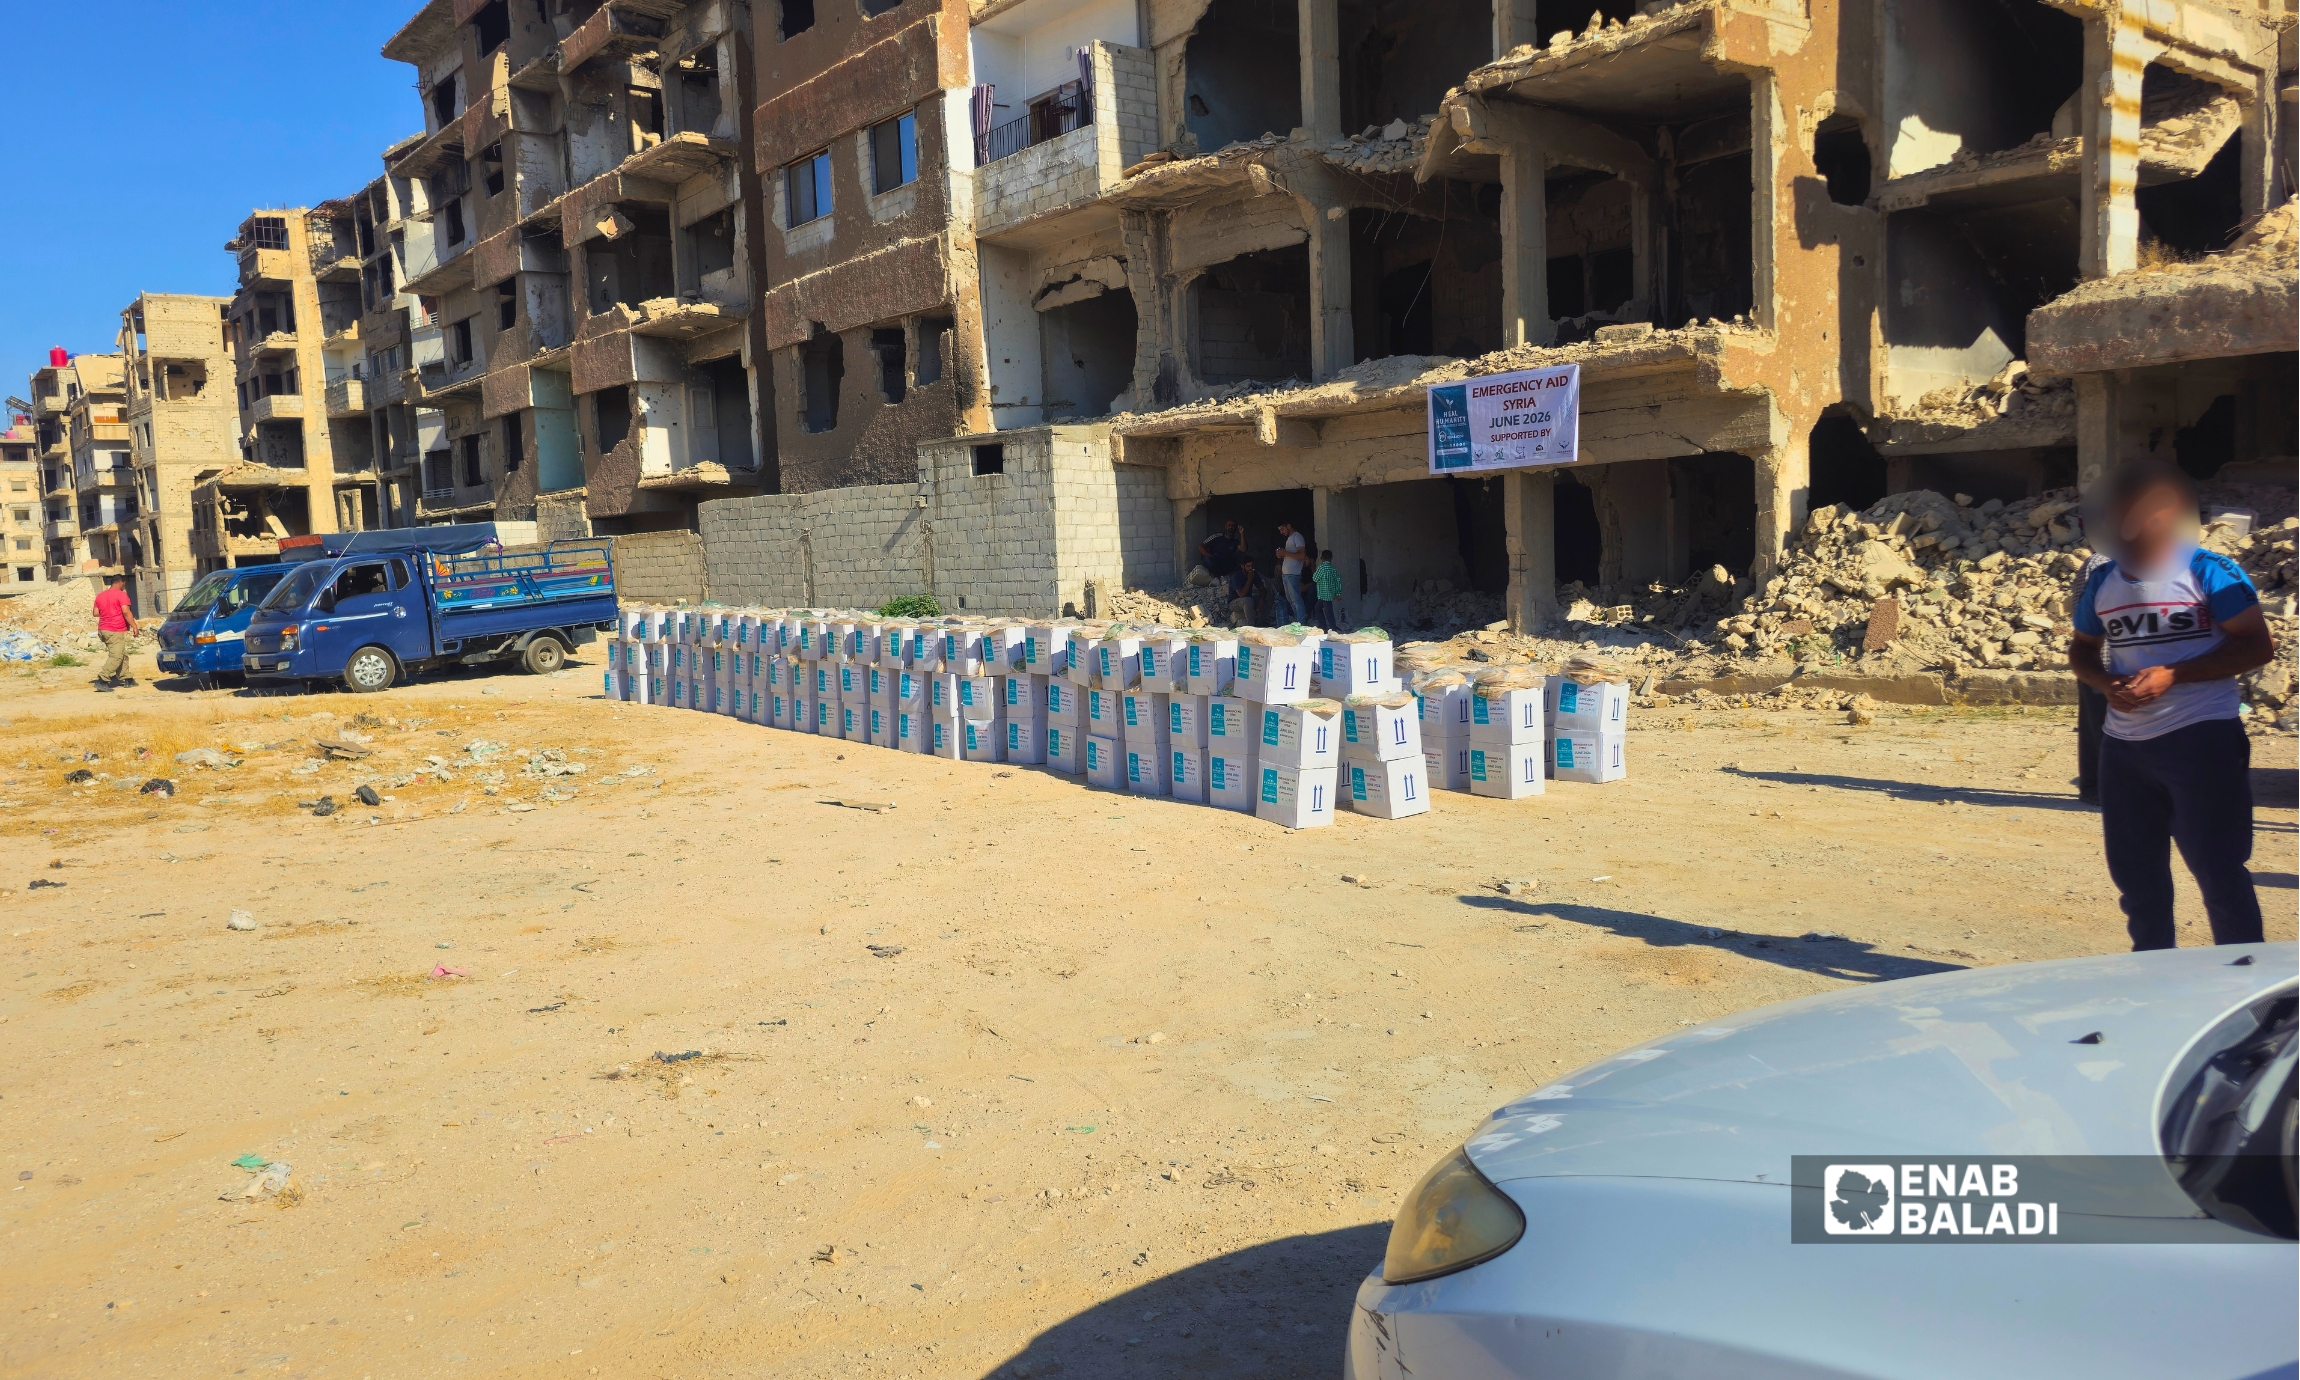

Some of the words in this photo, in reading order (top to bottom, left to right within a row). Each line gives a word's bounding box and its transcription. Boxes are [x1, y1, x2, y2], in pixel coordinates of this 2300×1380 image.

[1472, 379, 1543, 398] EMERGENCY
[1546, 375, 1568, 389] AID
[1503, 397, 1536, 411] SYRIA
[1443, 410, 1459, 418] HEAL
[1489, 414, 1520, 428] JUNE
[1523, 411, 1551, 425] 2026
[1490, 430, 1539, 443] SUPPORTED
[1540, 428, 1552, 437] BY
